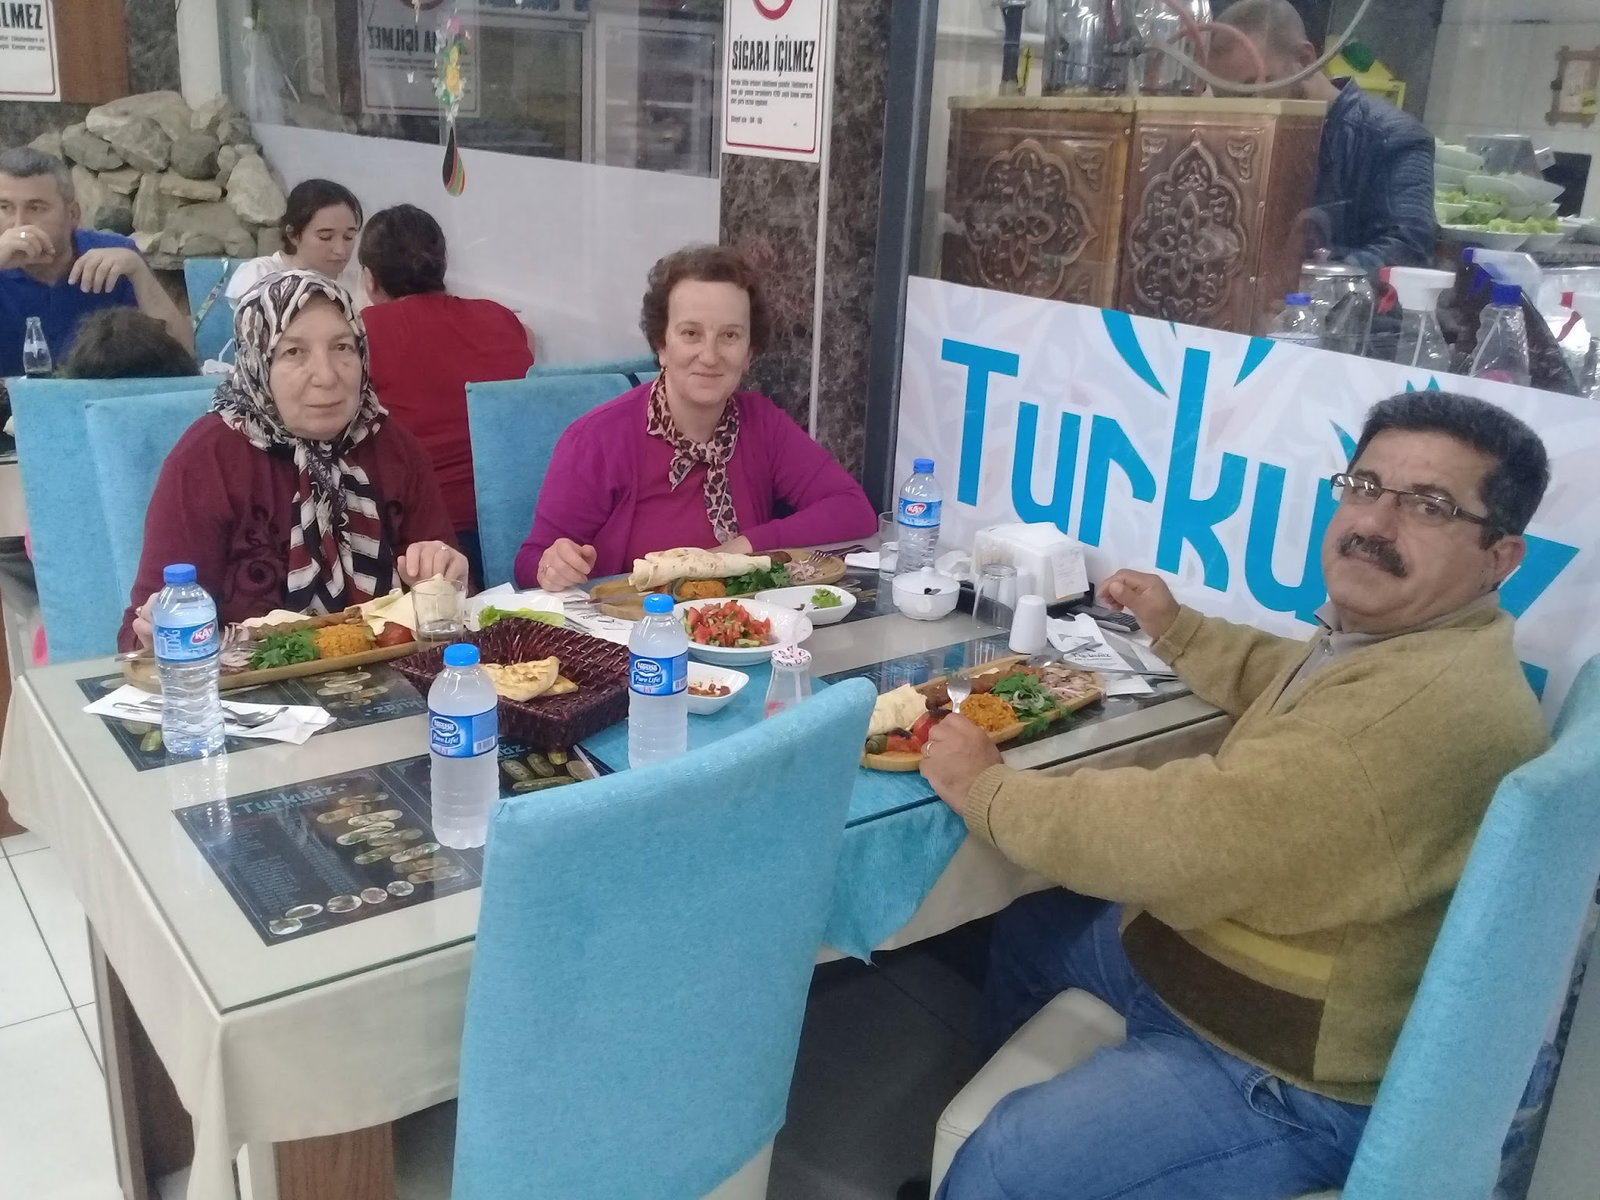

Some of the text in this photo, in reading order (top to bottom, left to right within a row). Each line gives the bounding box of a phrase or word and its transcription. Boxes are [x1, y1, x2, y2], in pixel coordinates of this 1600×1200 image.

[0, 2, 43, 30] LMEZ
[732, 34, 816, 77] SİGARA İÇİLMEZ
